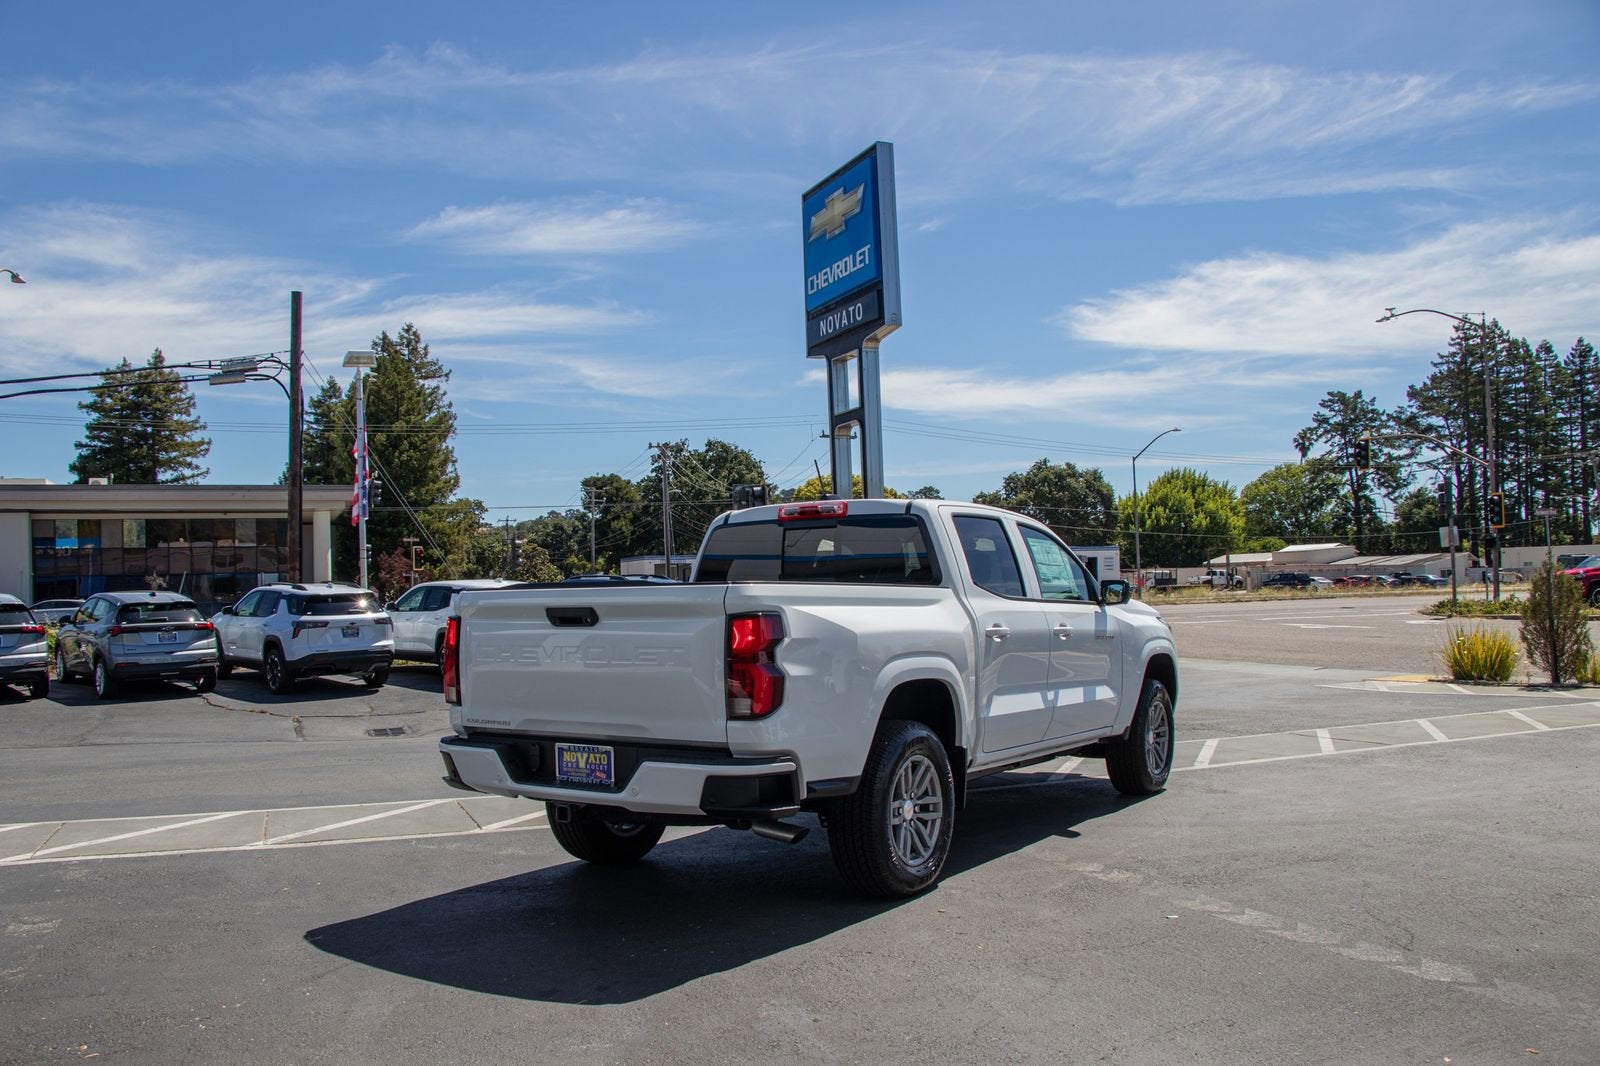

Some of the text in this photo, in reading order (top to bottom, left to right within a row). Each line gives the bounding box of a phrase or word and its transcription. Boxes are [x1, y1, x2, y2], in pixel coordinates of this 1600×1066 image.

[808, 244, 871, 295] CHEVROLET
[819, 302, 863, 337] NOVATO
[474, 644, 686, 666] CHEVROLET
[563, 751, 608, 768] NOVATO
